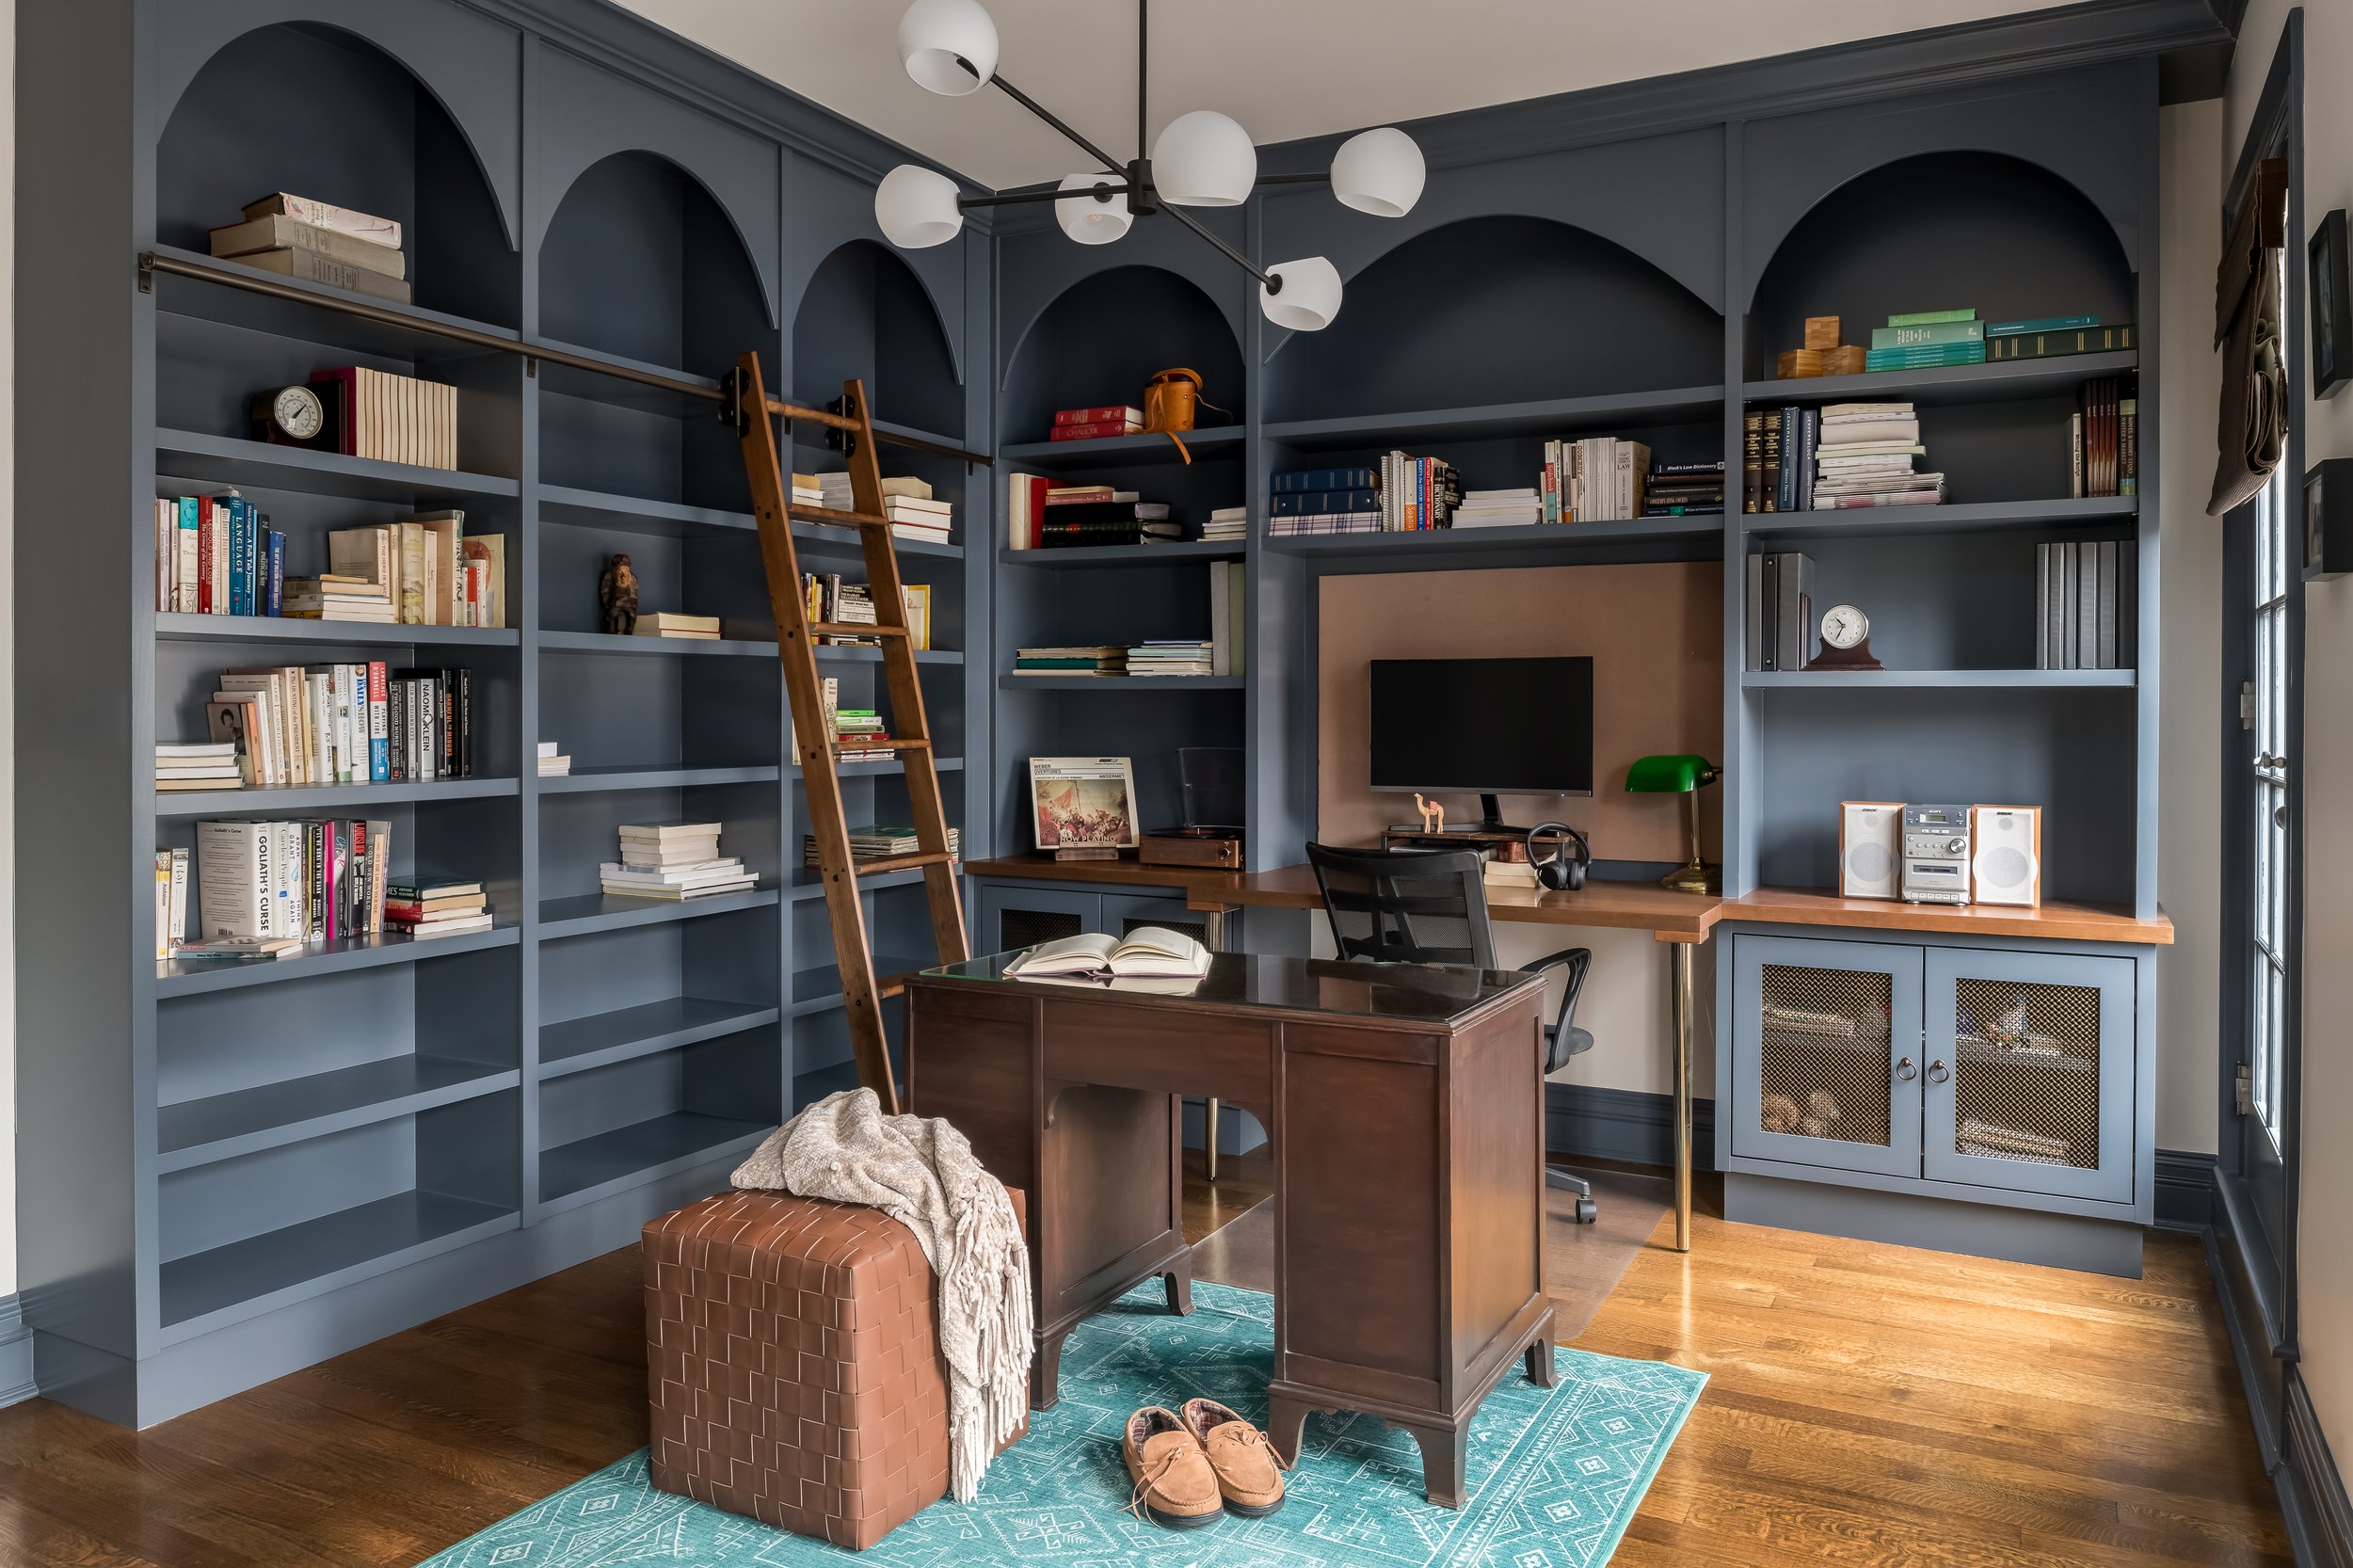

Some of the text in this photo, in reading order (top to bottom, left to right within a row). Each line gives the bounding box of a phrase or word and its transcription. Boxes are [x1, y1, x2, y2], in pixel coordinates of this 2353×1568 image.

[354, 823, 365, 856] LANDSLIDE
[174, 864, 184, 885] 1491
[259, 836, 268, 894] GOLIATH'S
[279, 864, 288, 888] People
[260, 897, 269, 931] CURSE
